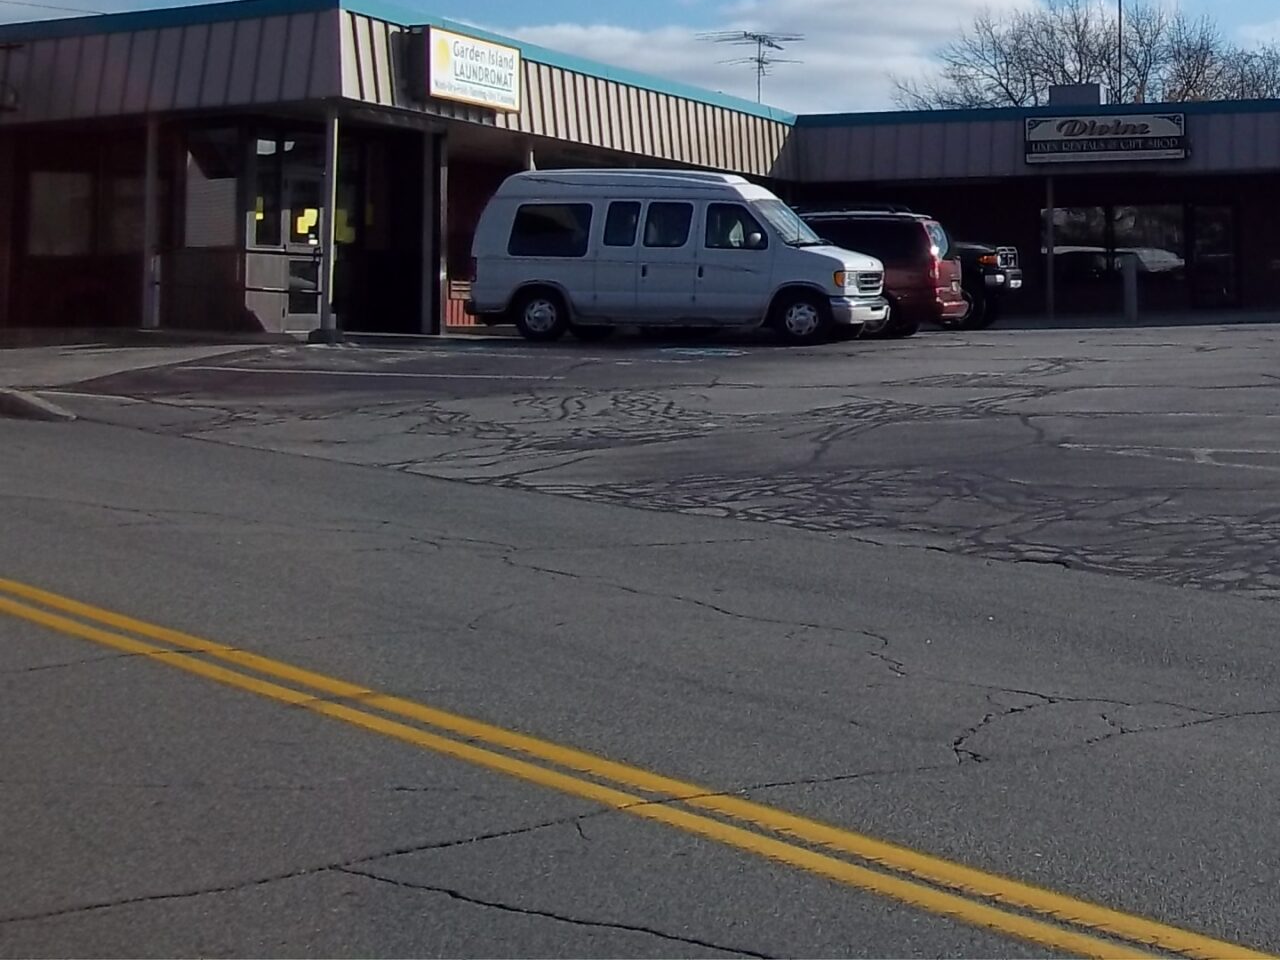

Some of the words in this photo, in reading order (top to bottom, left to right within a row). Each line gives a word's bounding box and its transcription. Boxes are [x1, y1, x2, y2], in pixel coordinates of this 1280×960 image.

[453, 41, 485, 62] Garden
[488, 50, 514, 70] Island
[454, 60, 513, 88] LAUNDROMAT
[1056, 119, 1151, 137] Divine
